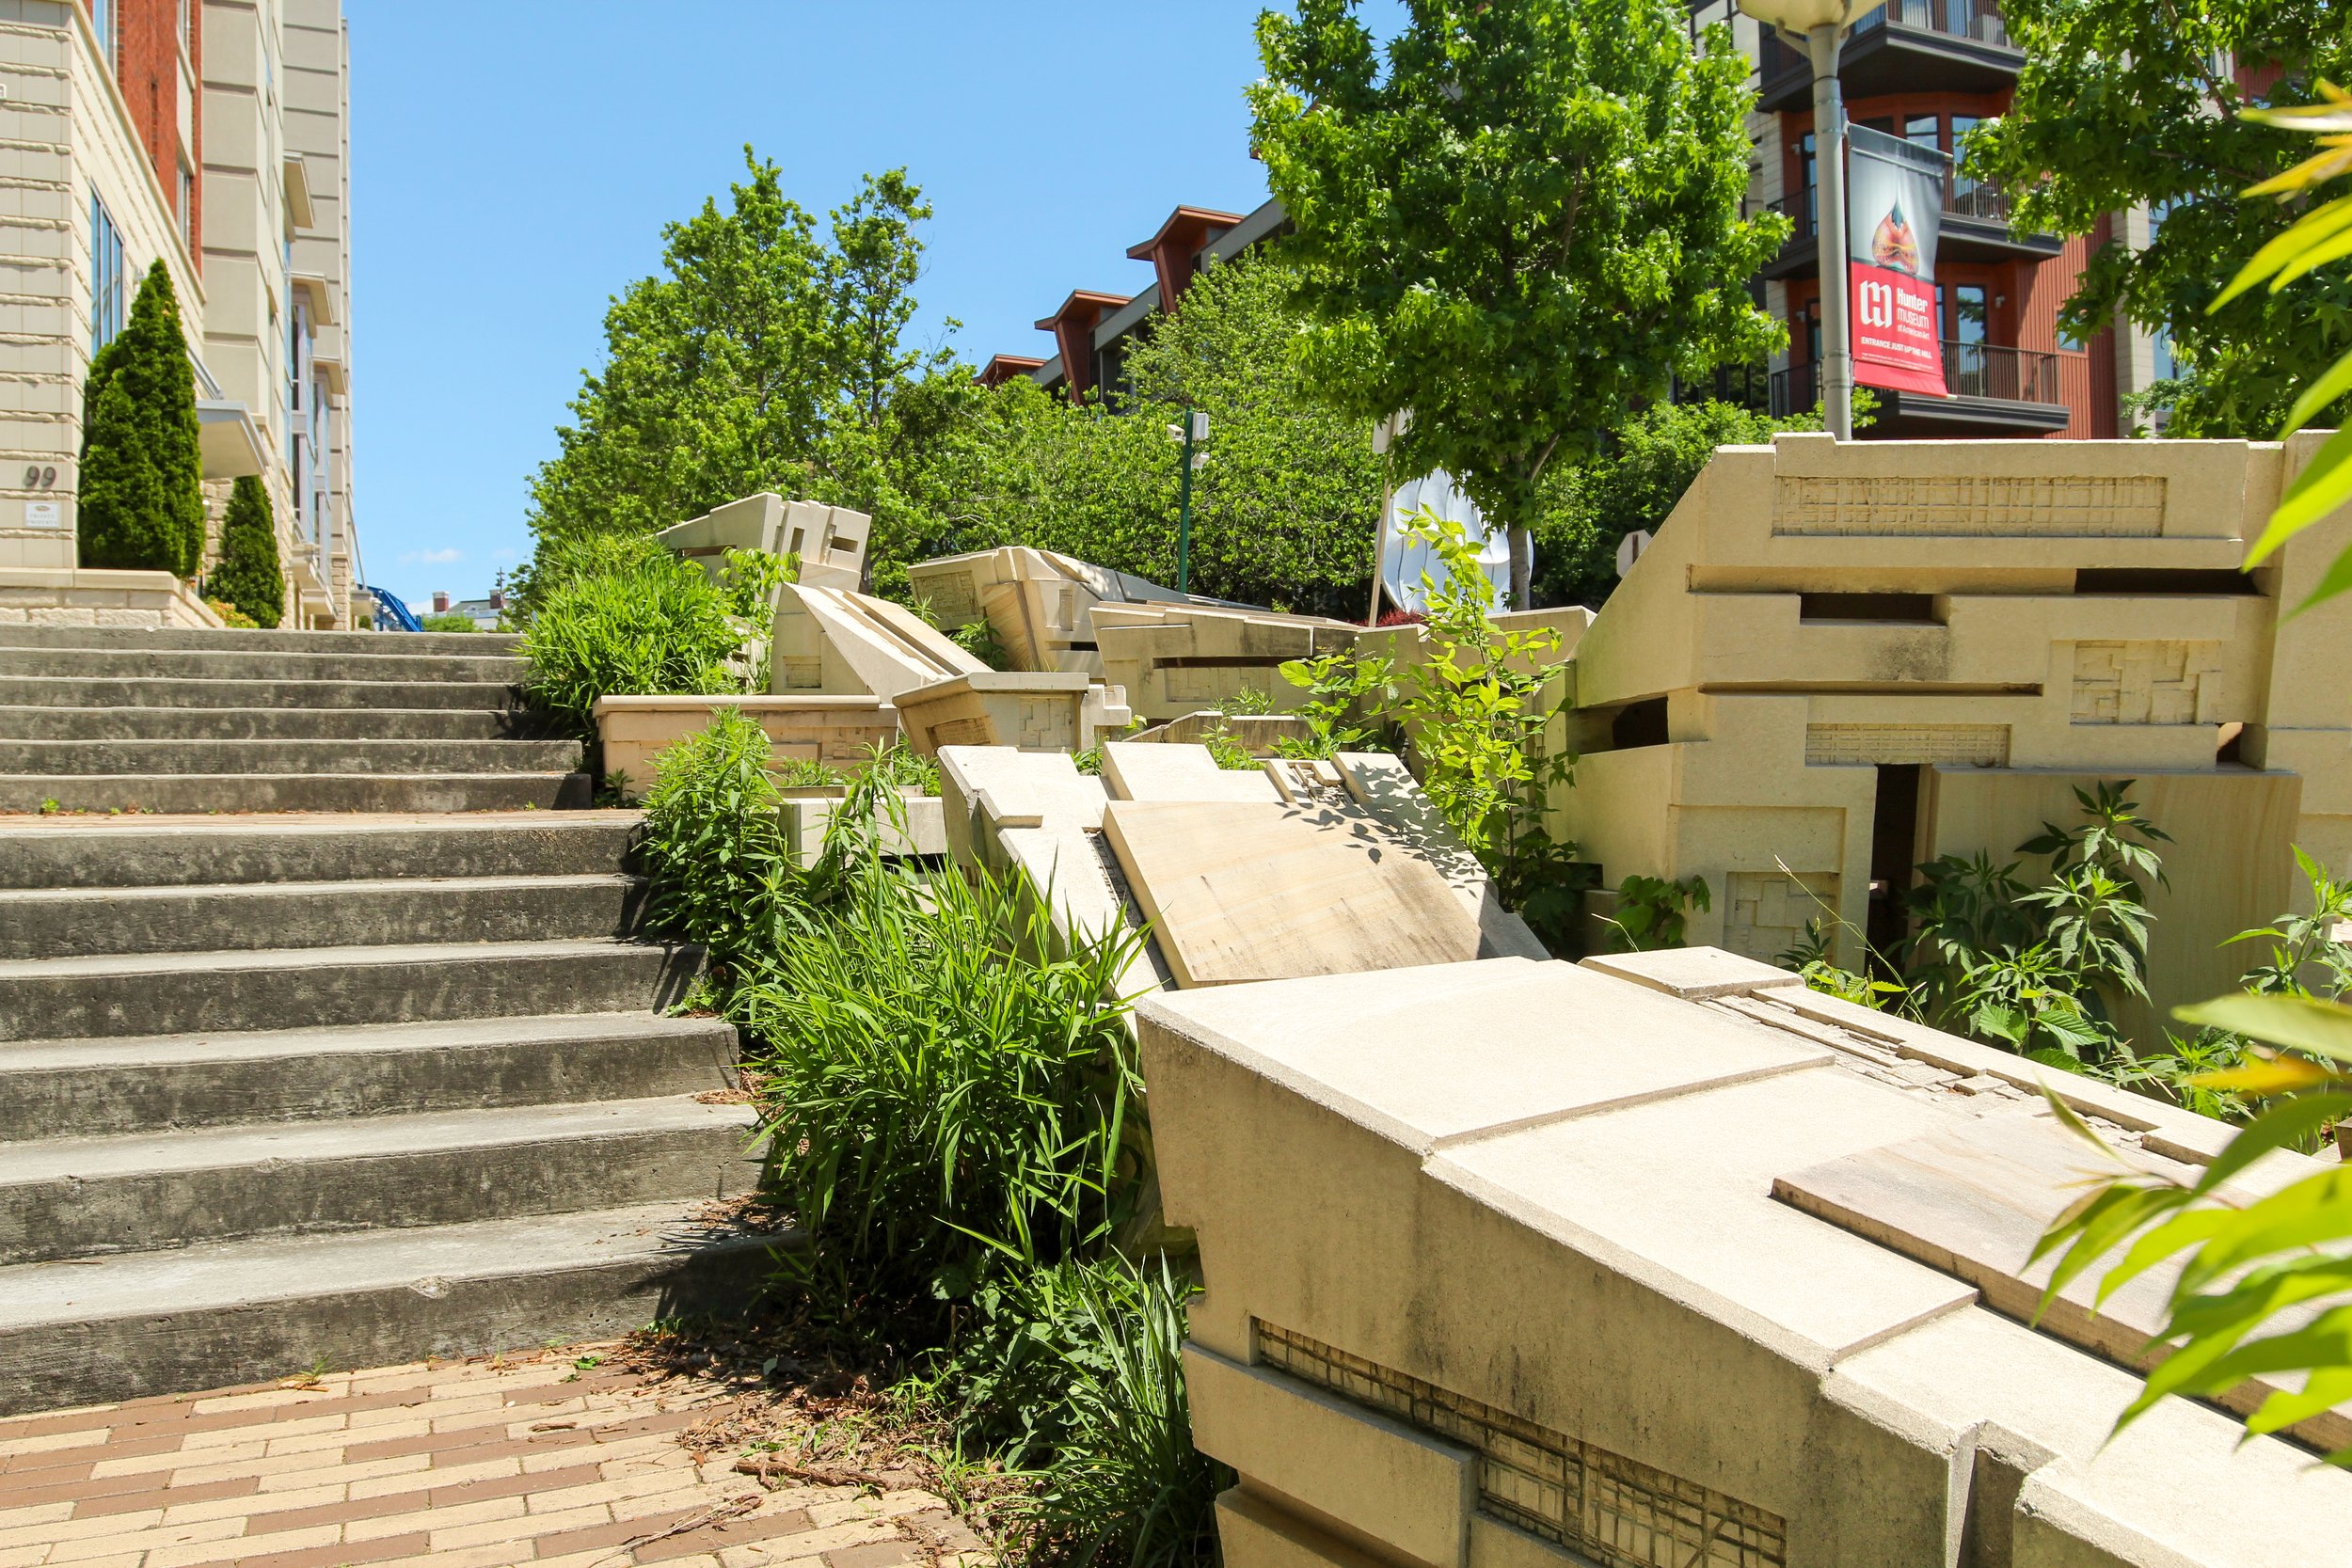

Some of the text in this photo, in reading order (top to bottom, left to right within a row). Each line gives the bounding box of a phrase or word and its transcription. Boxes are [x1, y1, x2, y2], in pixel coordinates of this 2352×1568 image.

[1897, 287, 1928, 312] Hunter
[1902, 325, 1923, 338] American
[1861, 336, 1933, 358] ENTRANCE JUST UP THE HILL
[23, 465, 56, 487] 99
